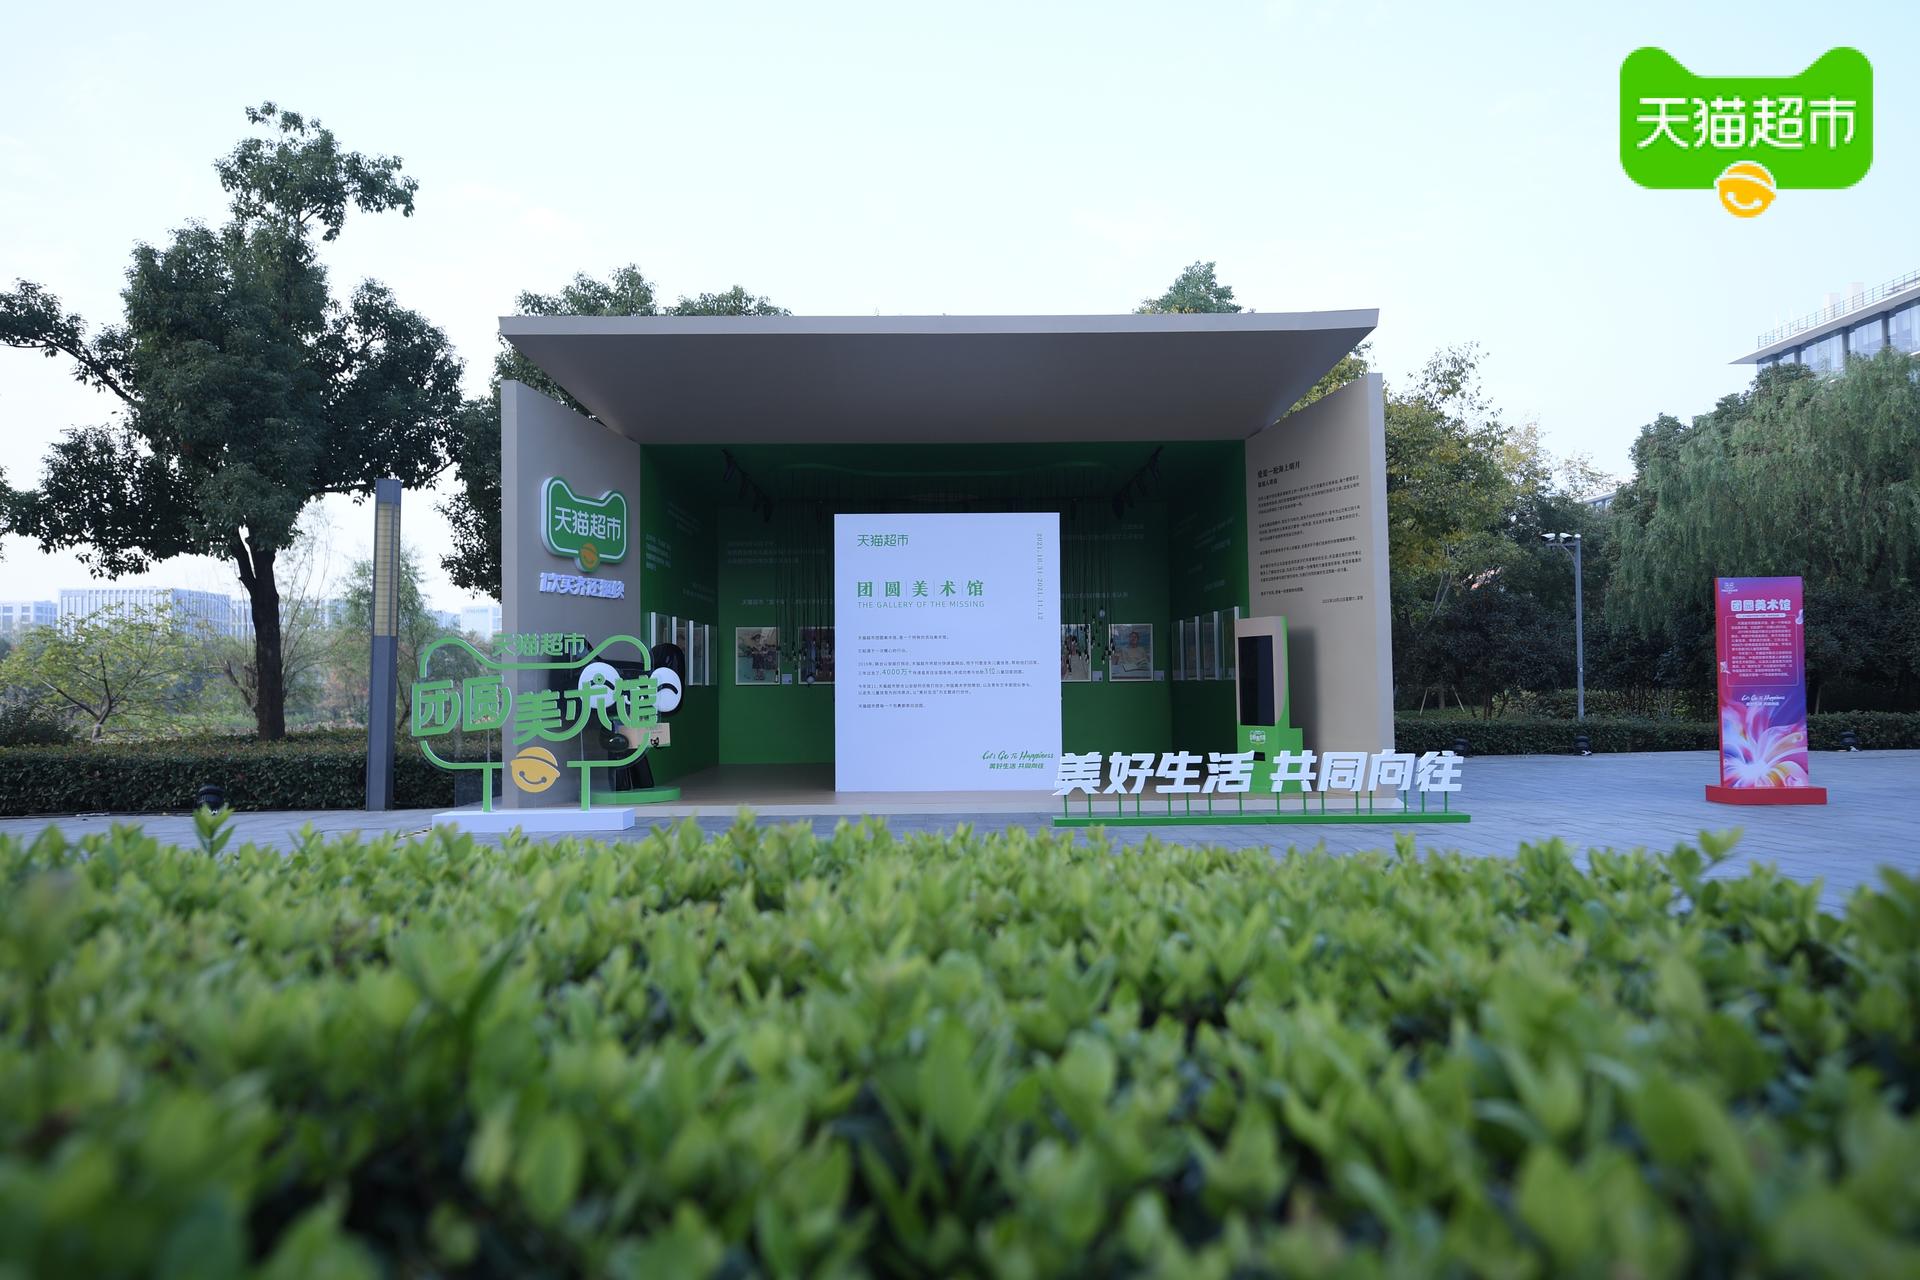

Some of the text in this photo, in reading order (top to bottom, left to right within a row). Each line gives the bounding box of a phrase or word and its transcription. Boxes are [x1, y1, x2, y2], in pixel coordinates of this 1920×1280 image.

[555, 507, 621, 541] 天猫超市
[857, 534, 909, 547] 天猫超市
[857, 580, 984, 597] 团圆美术馆
[492, 632, 586, 656] 天猫超市
[411, 673, 658, 745] 团圆美术馆
[1053, 749, 1465, 796] 美好生活 共同向往
